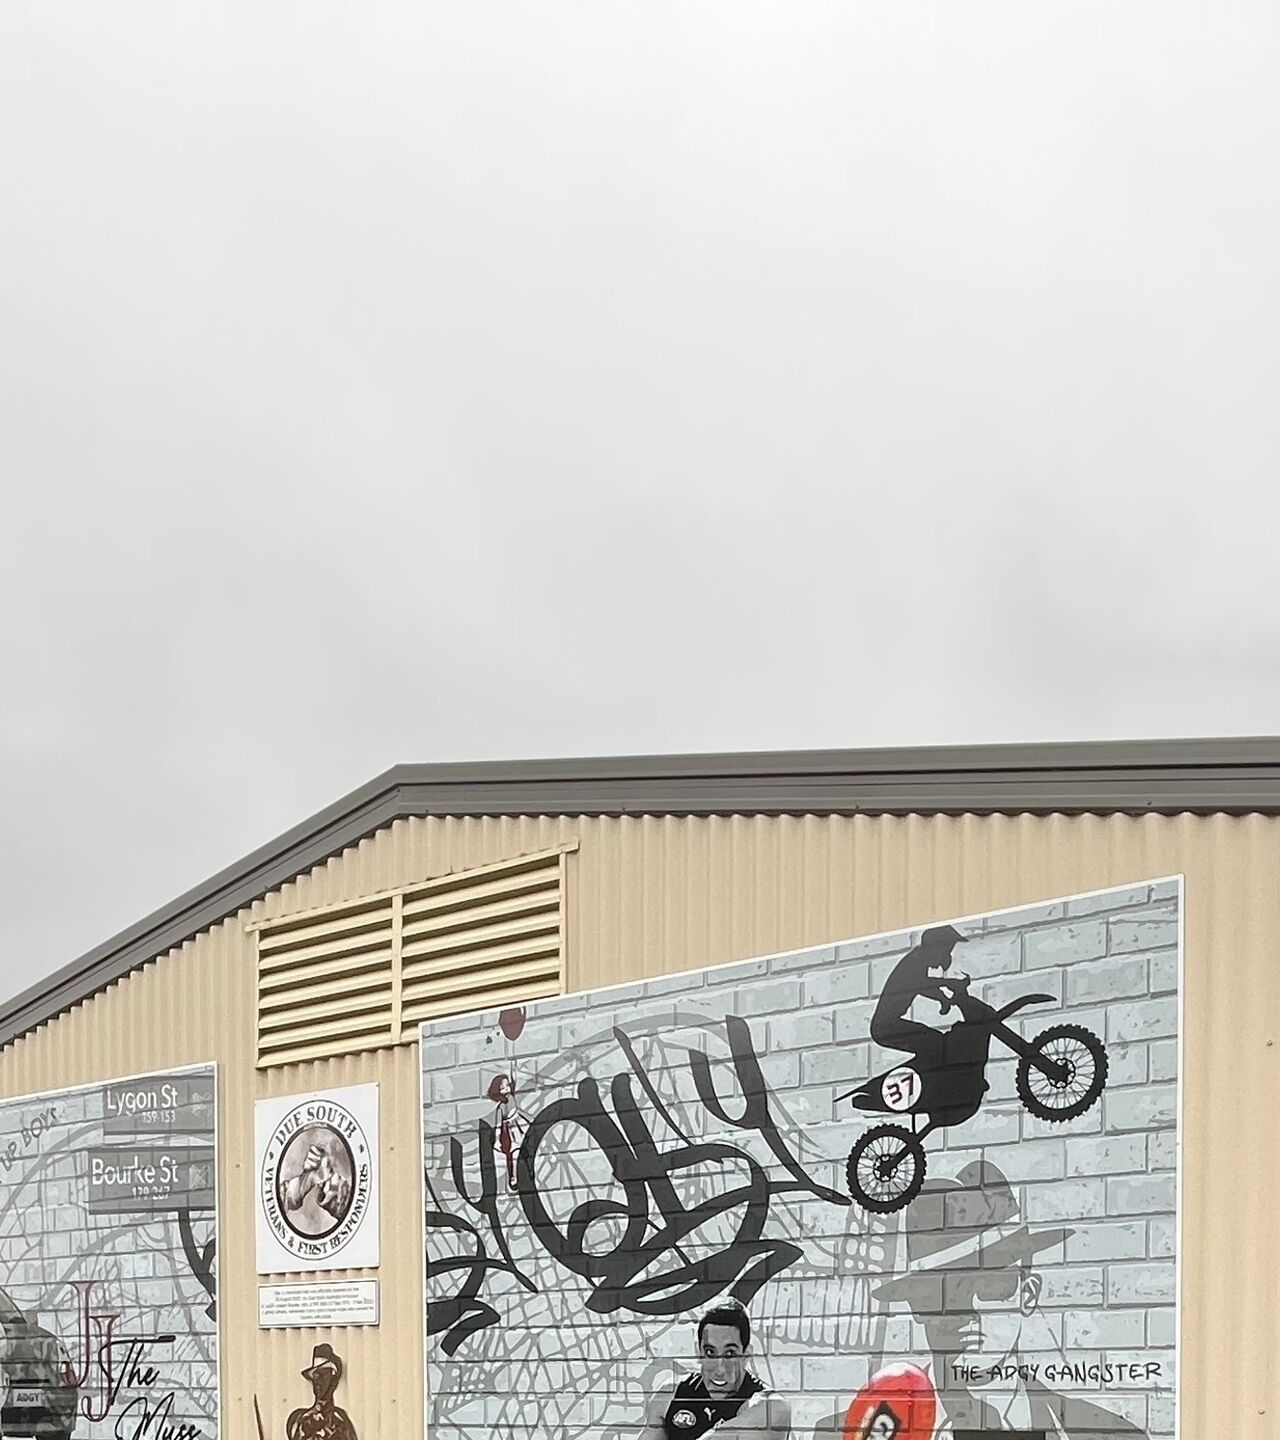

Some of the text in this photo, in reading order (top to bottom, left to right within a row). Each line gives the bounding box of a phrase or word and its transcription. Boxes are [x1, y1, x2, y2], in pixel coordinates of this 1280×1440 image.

[107, 1084, 178, 1117] Lygon St
[887, 1072, 914, 1104] 37
[275, 1105, 358, 1146] DUE SOUTH
[0, 1141, 17, 1171] UP
[92, 1155, 179, 1185] Bourke St
[265, 1163, 369, 1255] VETERANS & FIRST RESPONDERS
[98, 1335, 176, 1406] The
[951, 1361, 1163, 1385] THE ADGY GANGSTER
